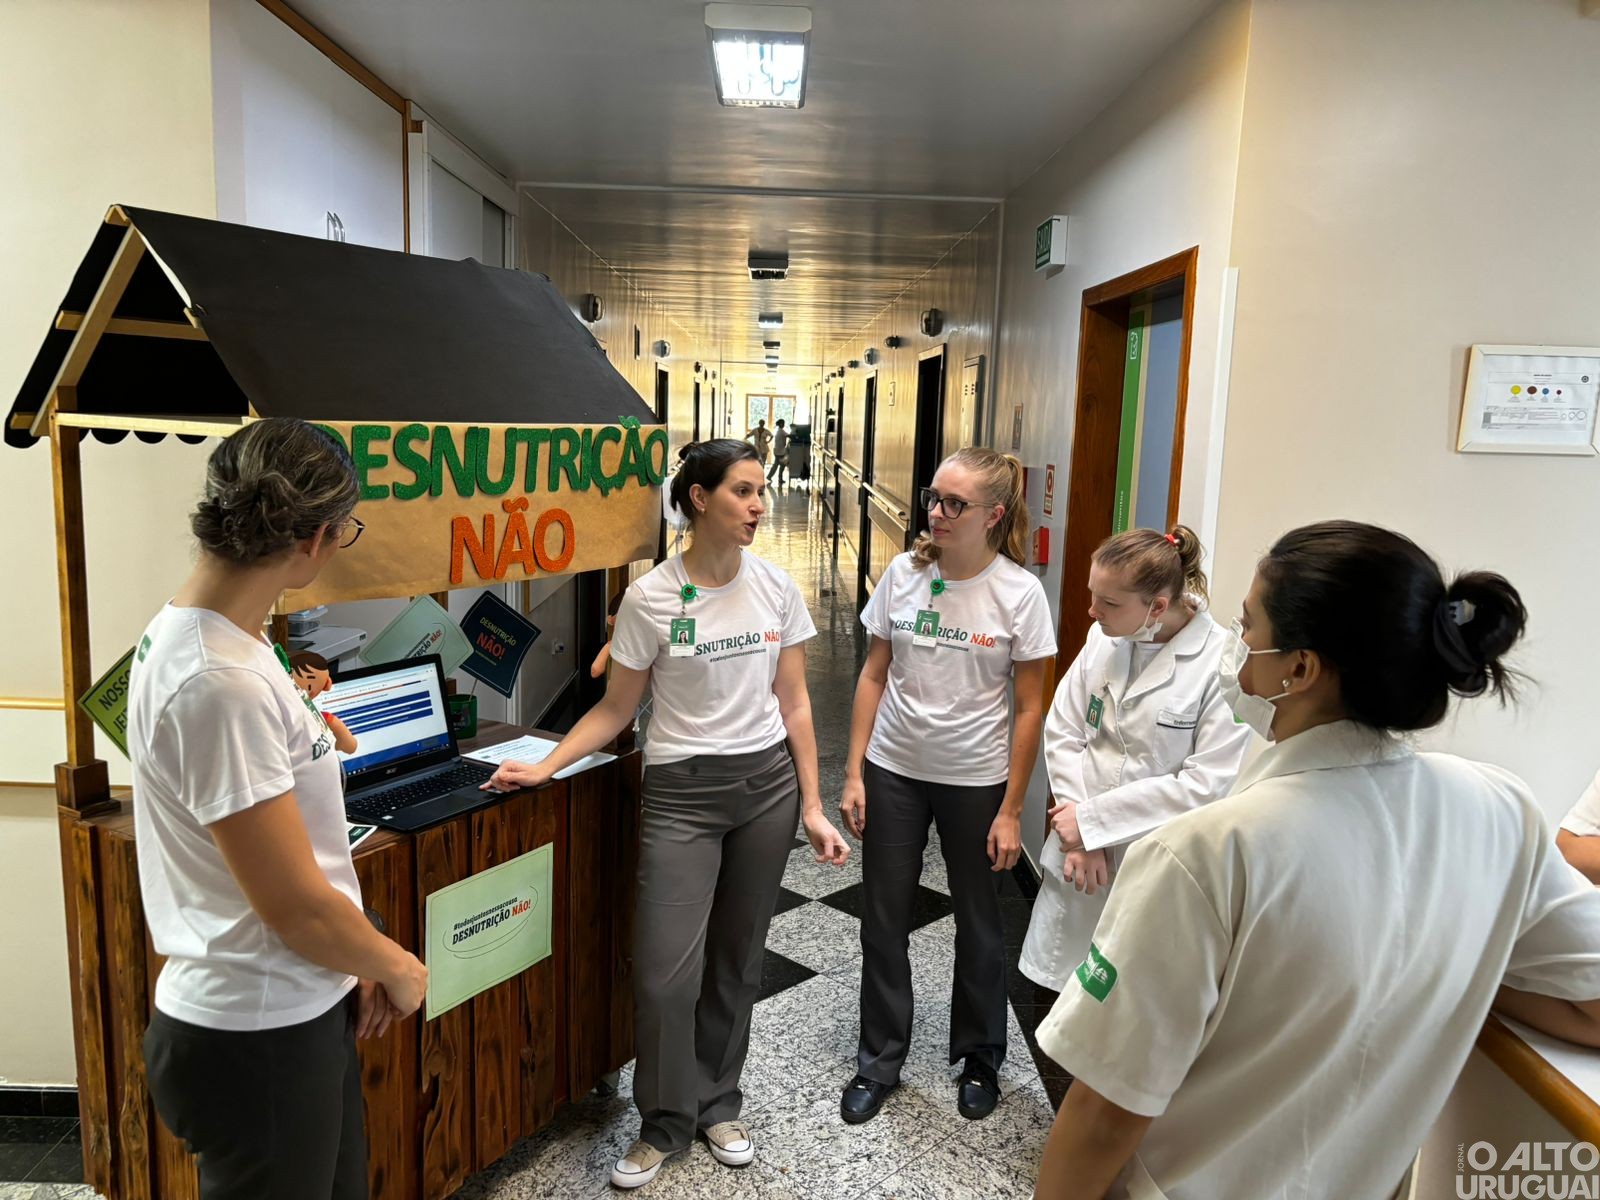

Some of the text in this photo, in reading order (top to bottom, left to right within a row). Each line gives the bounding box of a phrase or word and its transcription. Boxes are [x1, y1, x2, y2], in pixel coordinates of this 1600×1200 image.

[314, 415, 668, 500] ESNUTRIÇÃO
[450, 496, 576, 585] NÃO
[475, 632, 507, 660] NÃO!
[479, 616, 518, 647] DESNUTRIÇÃO
[694, 631, 761, 657] SNUTRIÇÃO
[894, 619, 968, 643] DESRIÇÃO
[970, 632, 997, 649] NÃO!
[113, 706, 128, 734] JEI
[452, 898, 532, 946] DESNUTRIÇÃO NÃO!
